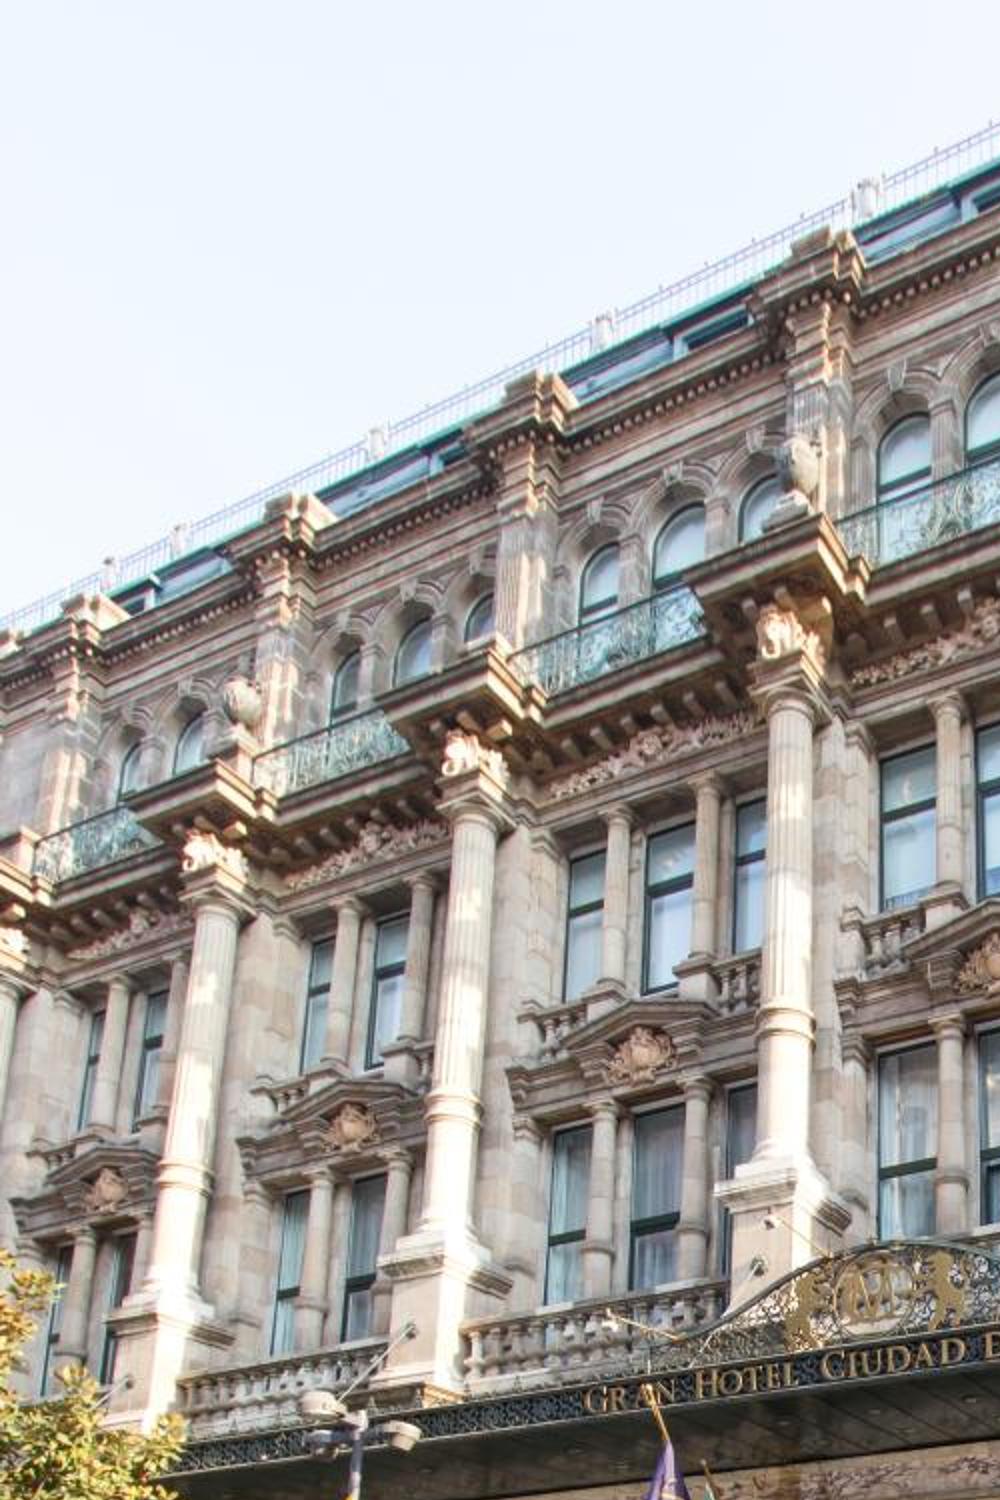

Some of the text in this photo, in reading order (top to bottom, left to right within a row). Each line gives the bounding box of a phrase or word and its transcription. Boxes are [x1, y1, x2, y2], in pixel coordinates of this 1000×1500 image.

[584, 1377, 675, 1413] GRAN
[695, 1361, 799, 1400] HOTEL
[822, 1337, 965, 1379] CIUDAD
